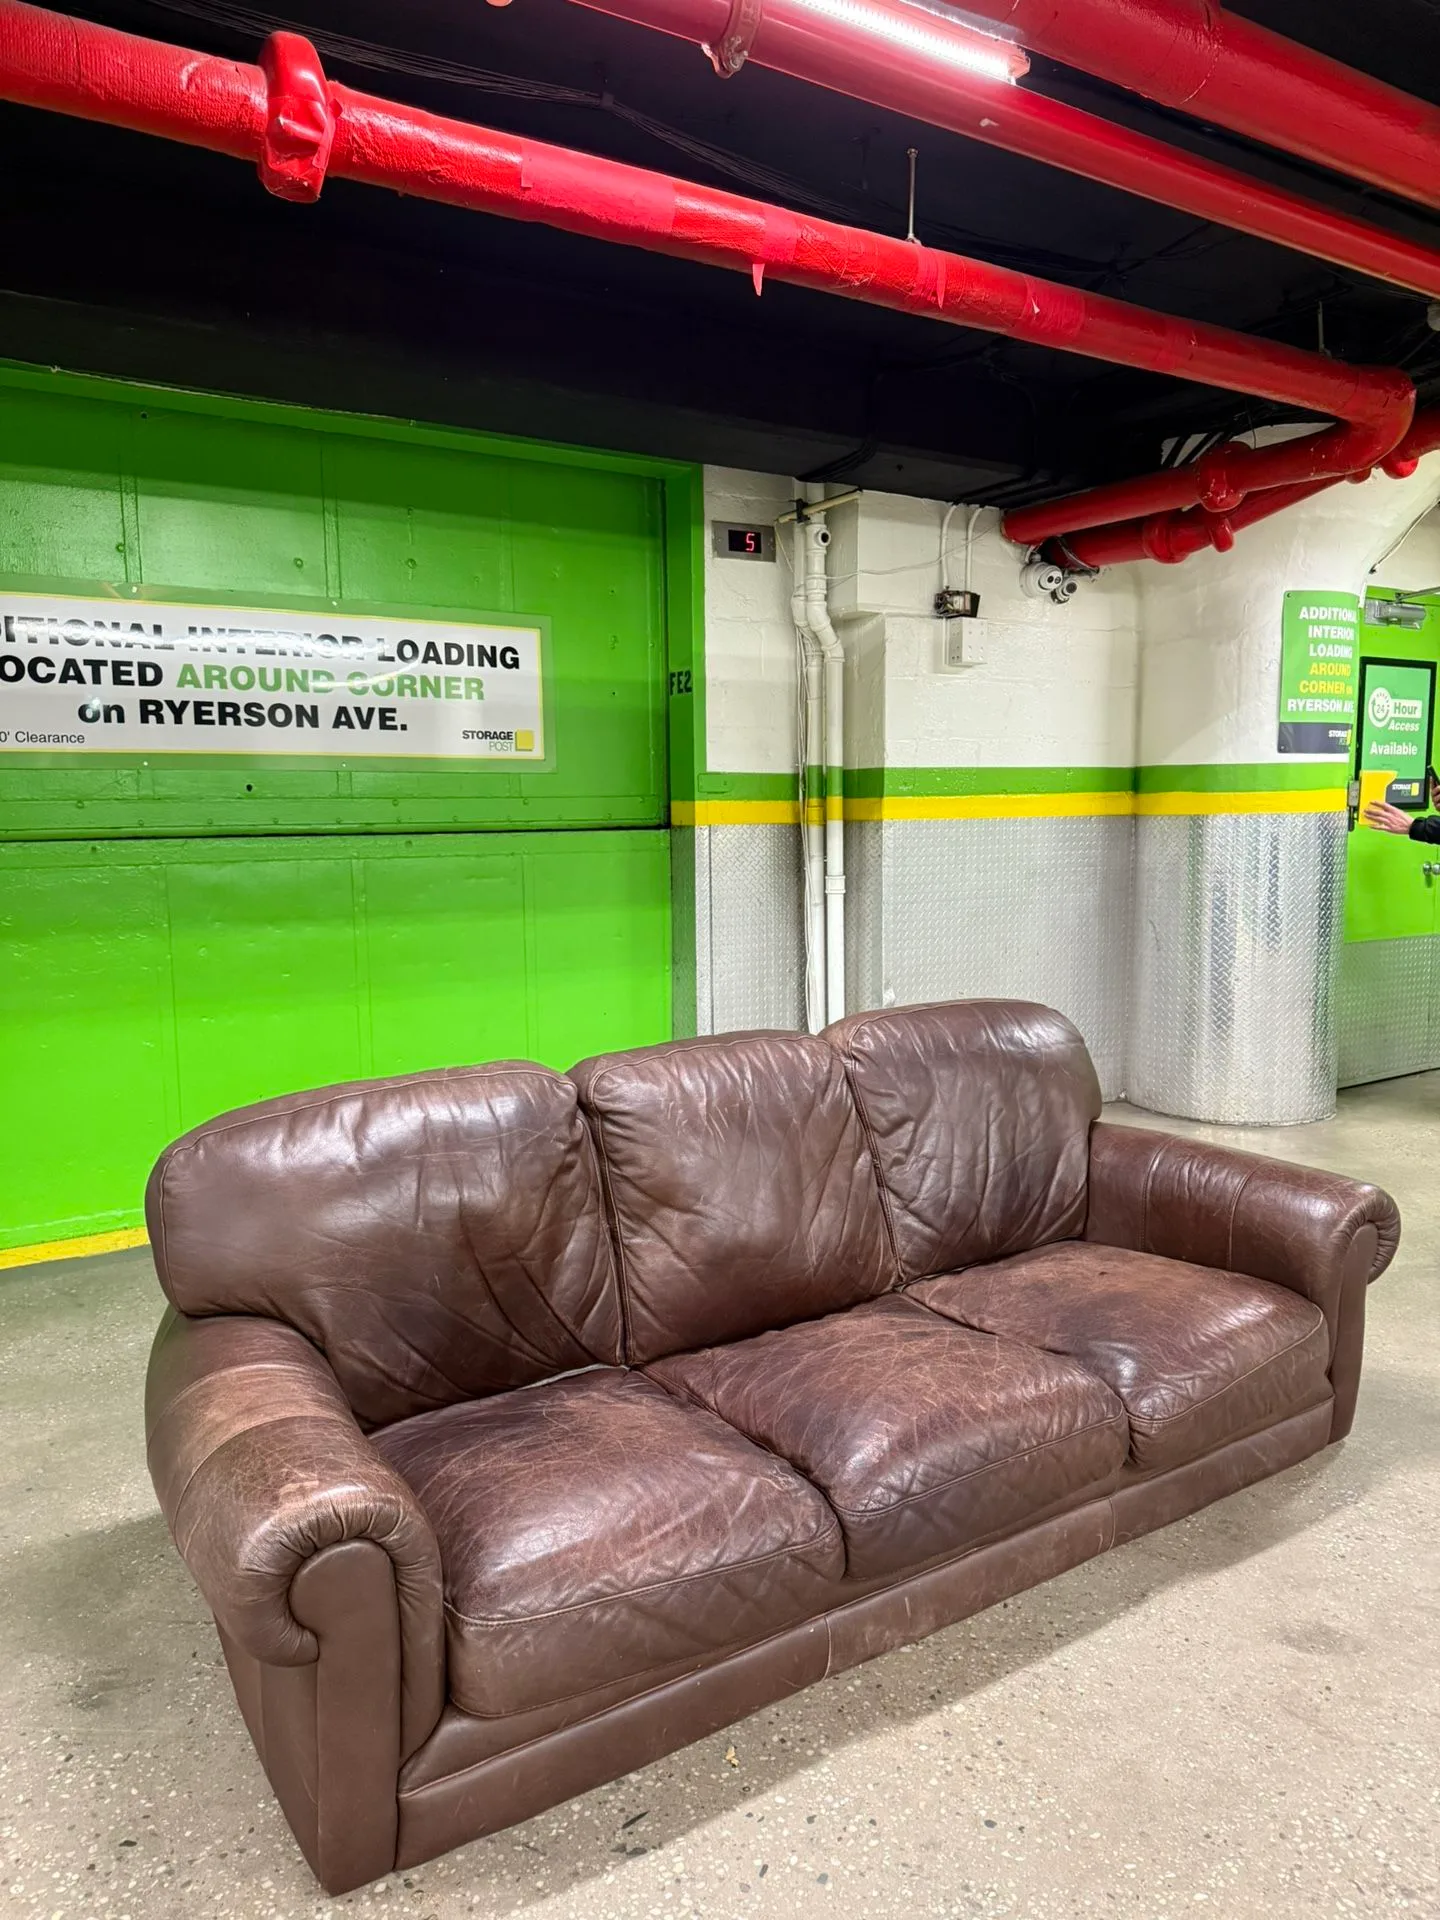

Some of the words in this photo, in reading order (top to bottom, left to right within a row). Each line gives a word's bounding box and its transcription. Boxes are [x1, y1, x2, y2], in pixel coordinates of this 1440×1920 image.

[0, 615, 175, 651] ITIONAL
[188, 625, 365, 661] INTERIOR
[376, 637, 520, 670] LOADING
[176, 663, 335, 694] AROUND
[346, 671, 485, 701] CORNER
[669, 670, 692, 696] FE2
[1299, 680, 1345, 694] CORNER
[1287, 698, 1342, 712] RYERSON
[1393, 702, 1418, 715] Hour
[77, 702, 125, 724] on
[139, 699, 319, 729] RYERSON
[332, 705, 408, 731] AVE.
[1388, 719, 1420, 732] Access
[15, 730, 85, 744] Clearance
[462, 729, 514, 741] STORAGE
[488, 741, 513, 751] POST
[1370, 741, 1418, 756] Available
